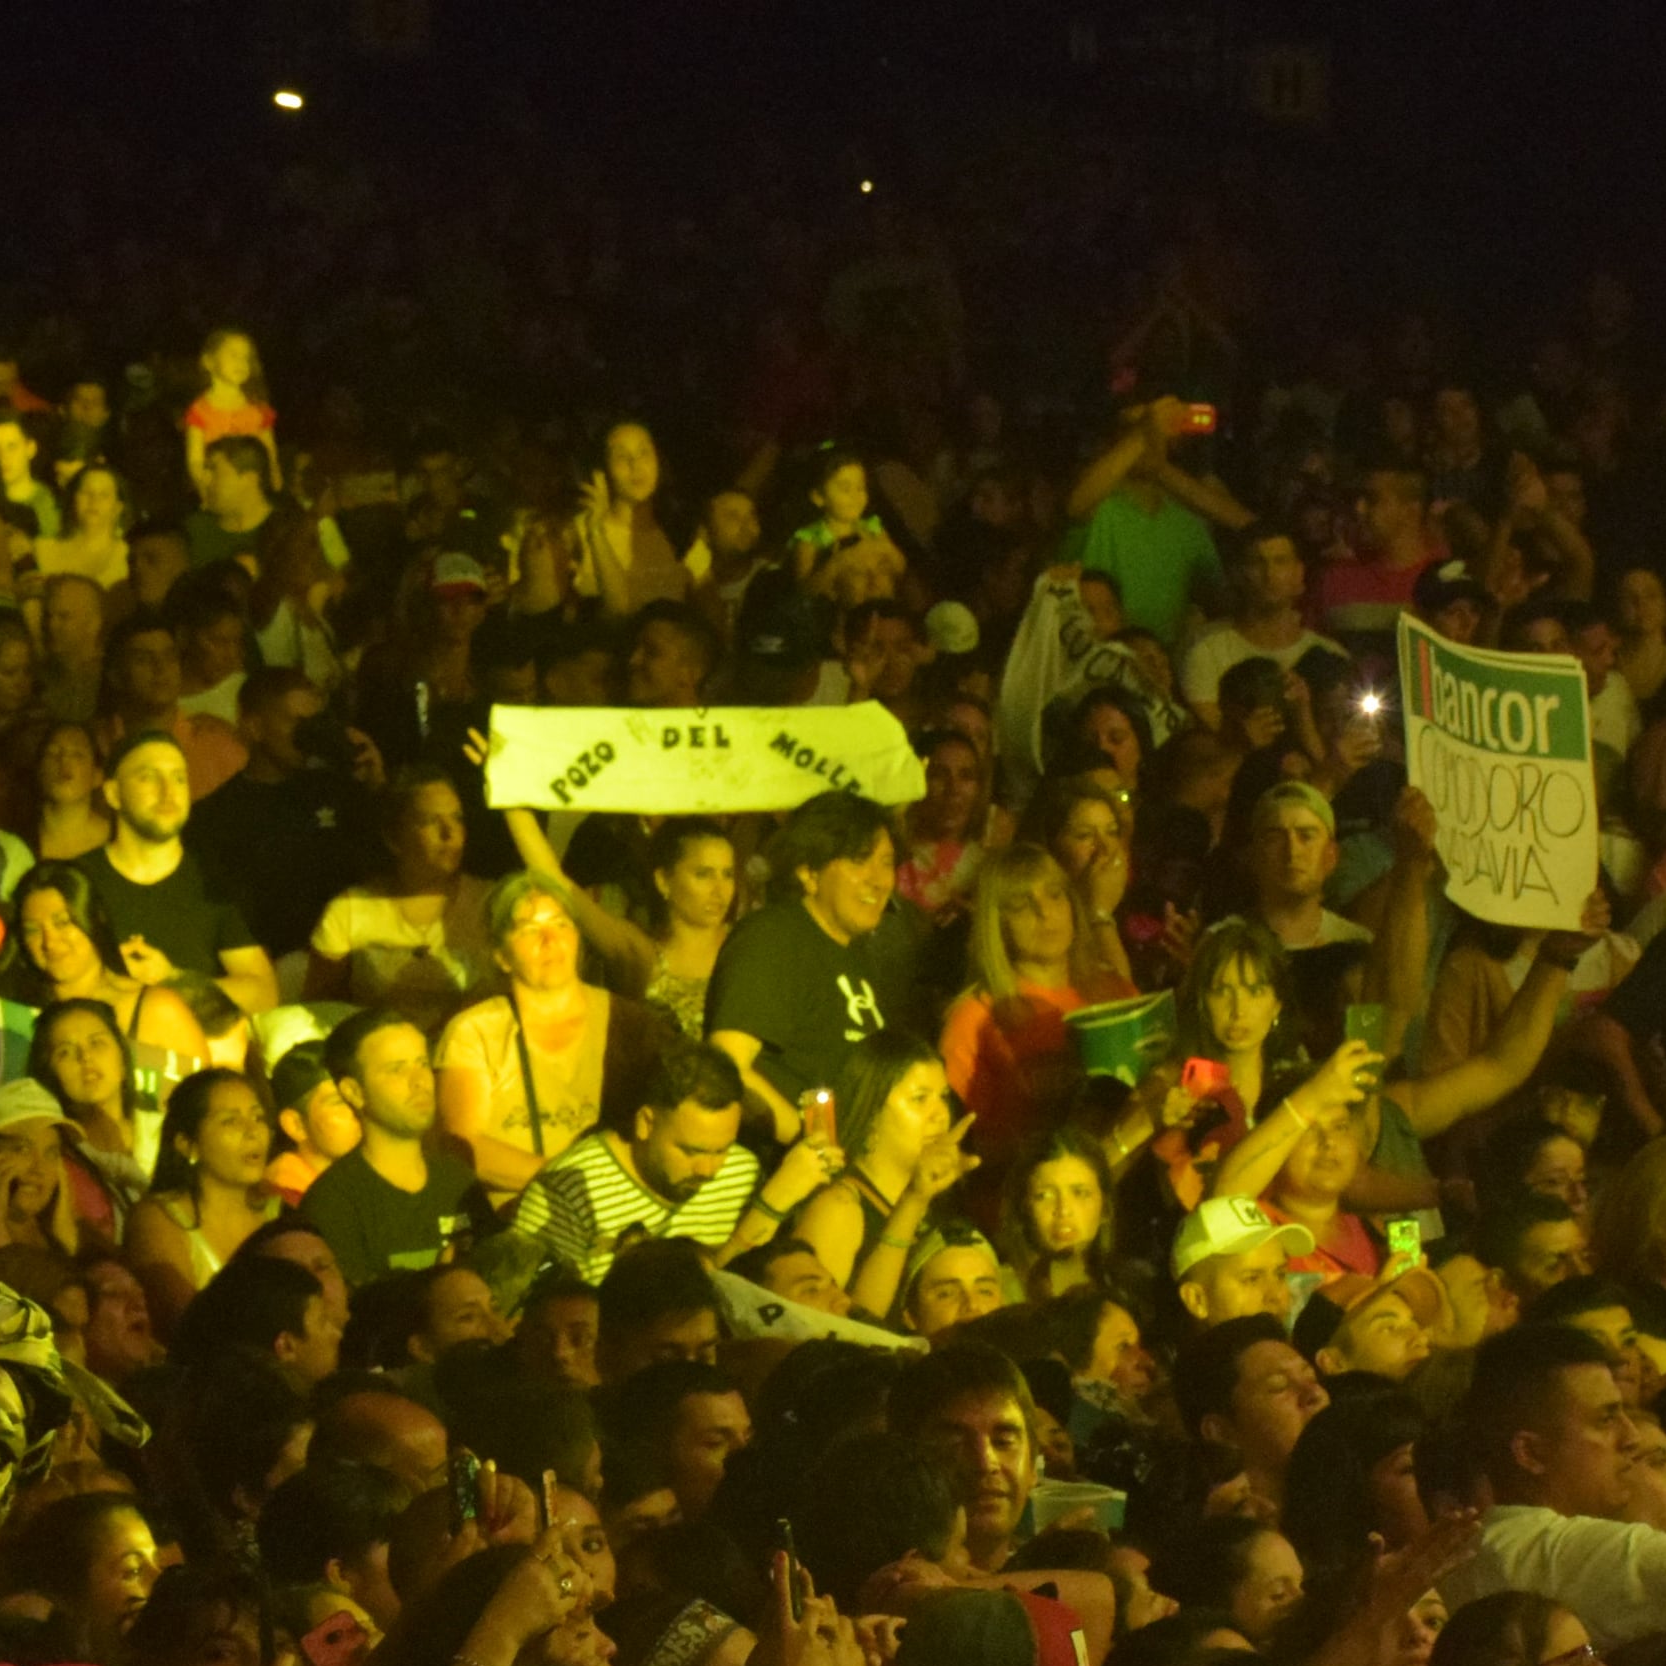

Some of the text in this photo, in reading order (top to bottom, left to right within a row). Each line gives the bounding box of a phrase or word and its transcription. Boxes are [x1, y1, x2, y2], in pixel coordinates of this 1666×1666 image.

[1430, 645, 1560, 754] bancor
[549, 738, 618, 806] POZO
[661, 725, 731, 750] DEL
